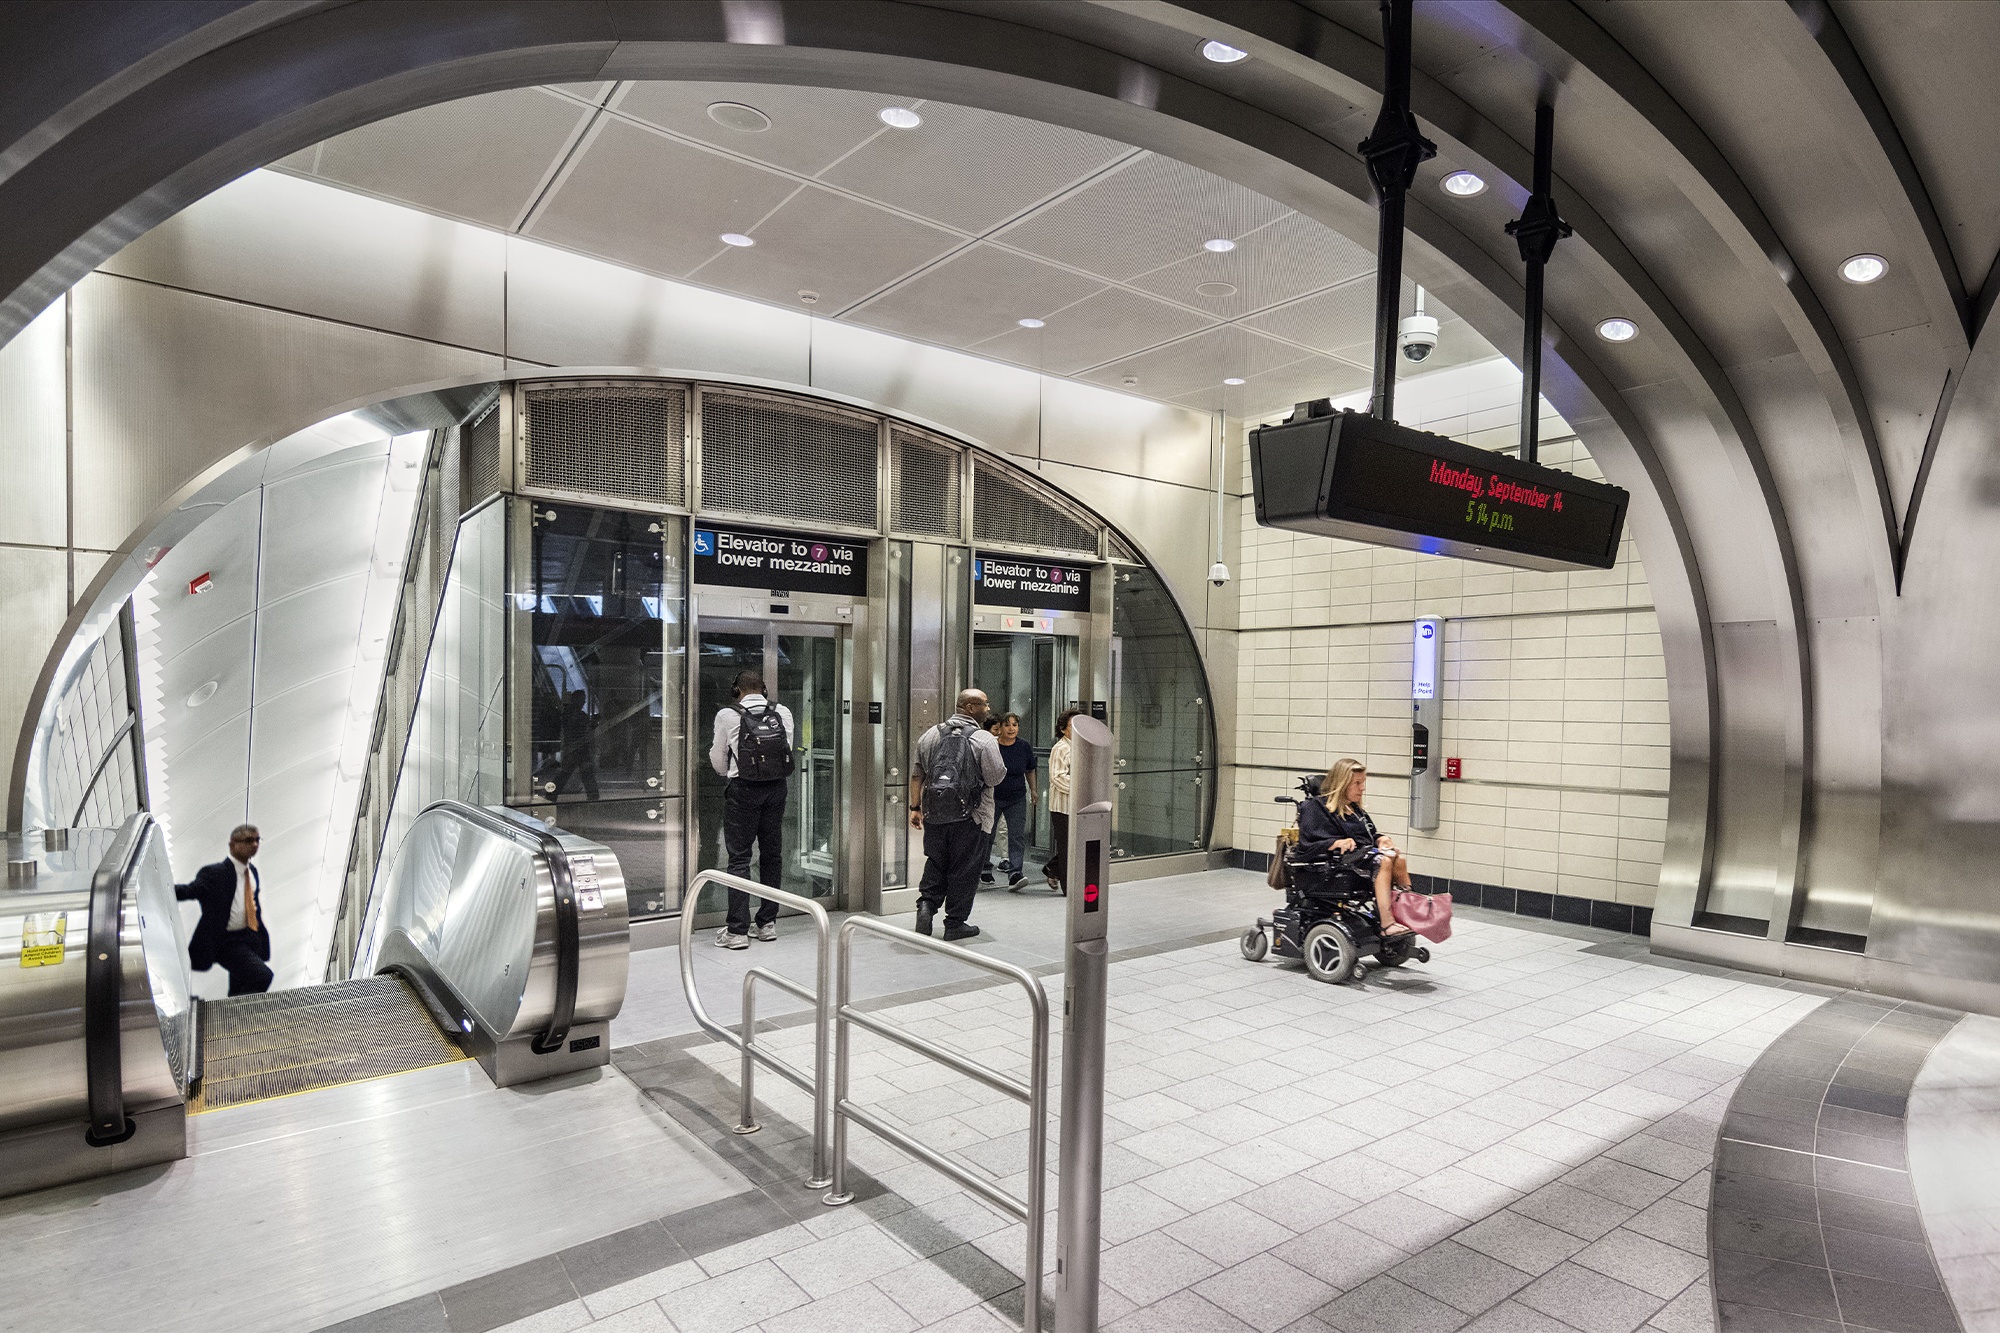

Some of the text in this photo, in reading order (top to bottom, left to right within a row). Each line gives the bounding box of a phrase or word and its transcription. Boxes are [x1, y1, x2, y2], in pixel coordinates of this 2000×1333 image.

[1429, 459, 1563, 513] Monday, September 14
[1489, 511, 1514, 532] p.m.
[717, 533, 785, 554] Elevator
[791, 541, 808, 556] to
[832, 546, 853, 561] via
[717, 550, 852, 576] lower mezzanine
[983, 561, 1032, 577] Elevator
[1035, 567, 1048, 579] to
[1065, 570, 1081, 582] via
[983, 575, 1079, 595] lower mezzanine
